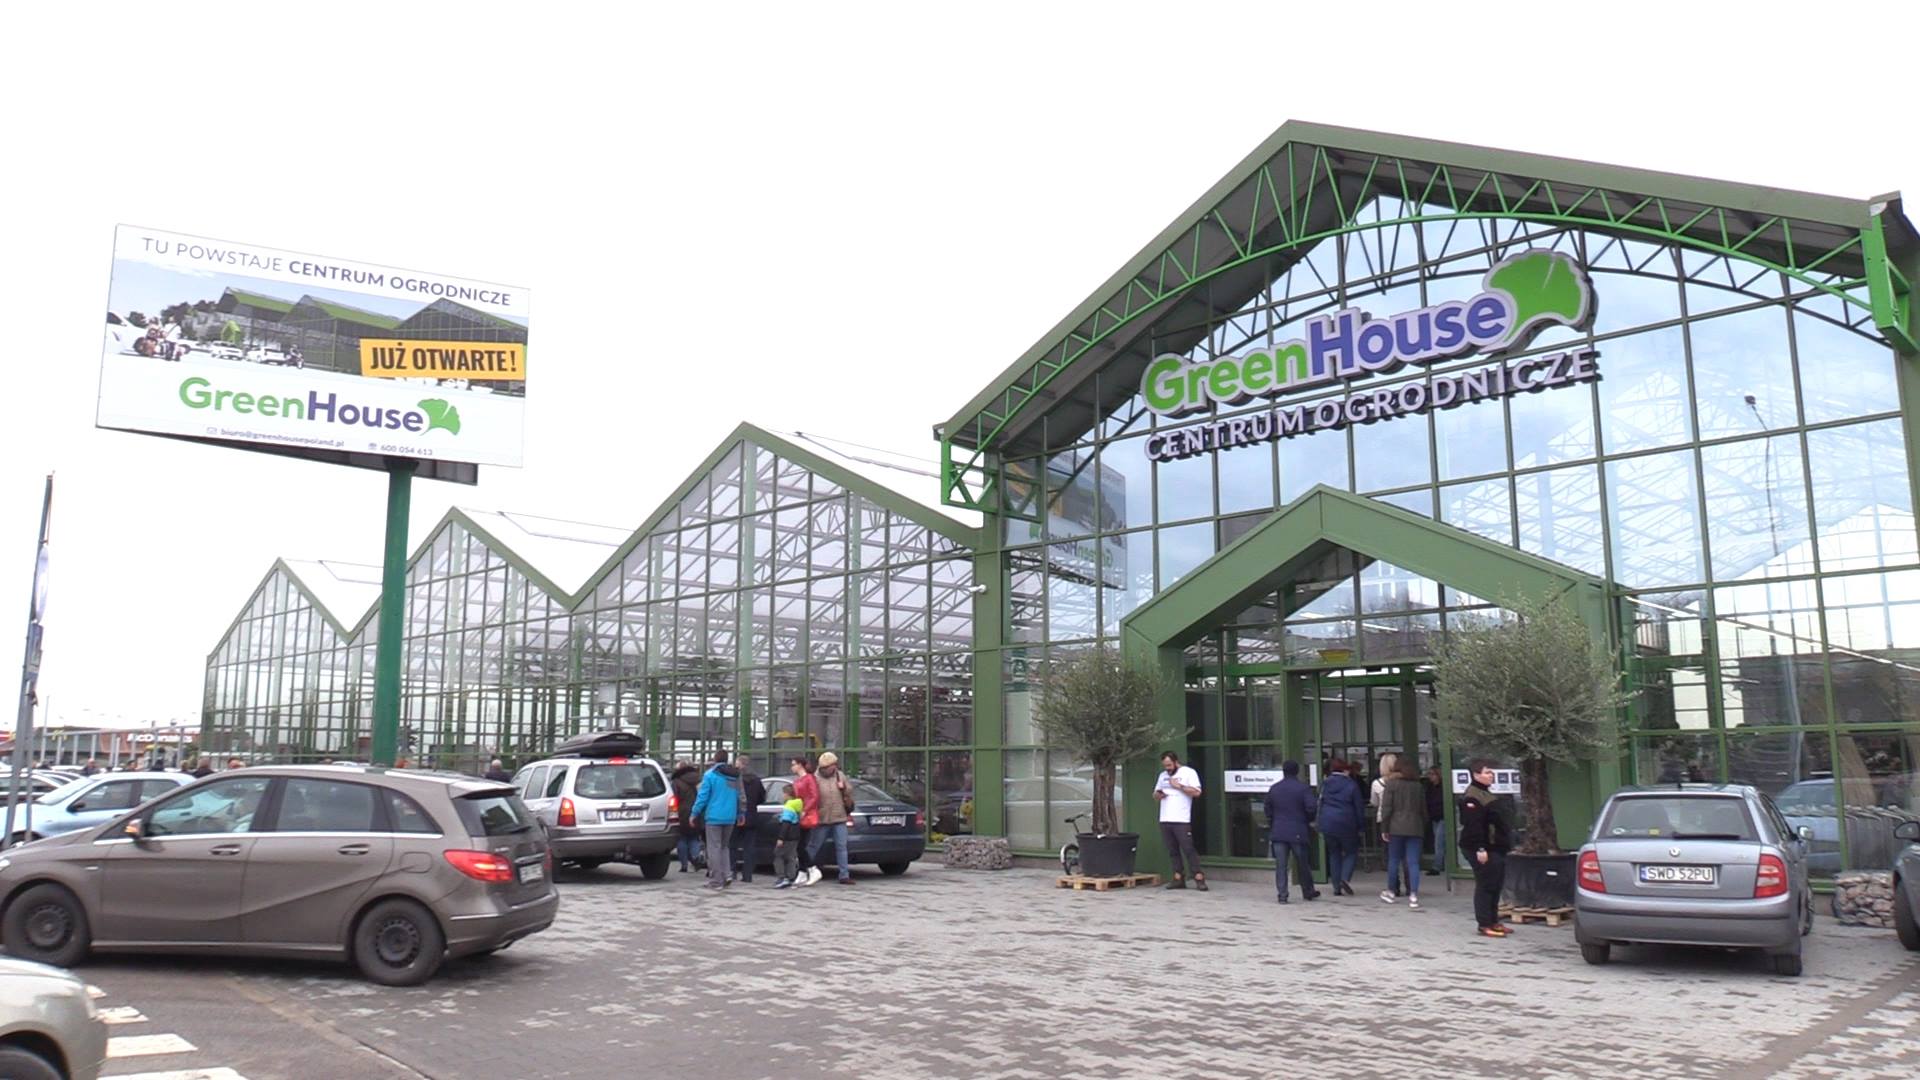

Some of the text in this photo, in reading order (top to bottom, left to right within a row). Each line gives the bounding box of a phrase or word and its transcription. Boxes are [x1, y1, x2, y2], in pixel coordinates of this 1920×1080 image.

[142, 237, 511, 306] TU POWSTAJE CENTRUM OGRODNICZE
[370, 341, 517, 372] JUŻ OTWARTE!
[1142, 295, 1509, 413] GreenHouse
[179, 376, 424, 433] GreenHouse
[1144, 347, 1599, 461] CENTRUM OGRODNICZE
[1647, 867, 1712, 880] SWD 52PU
